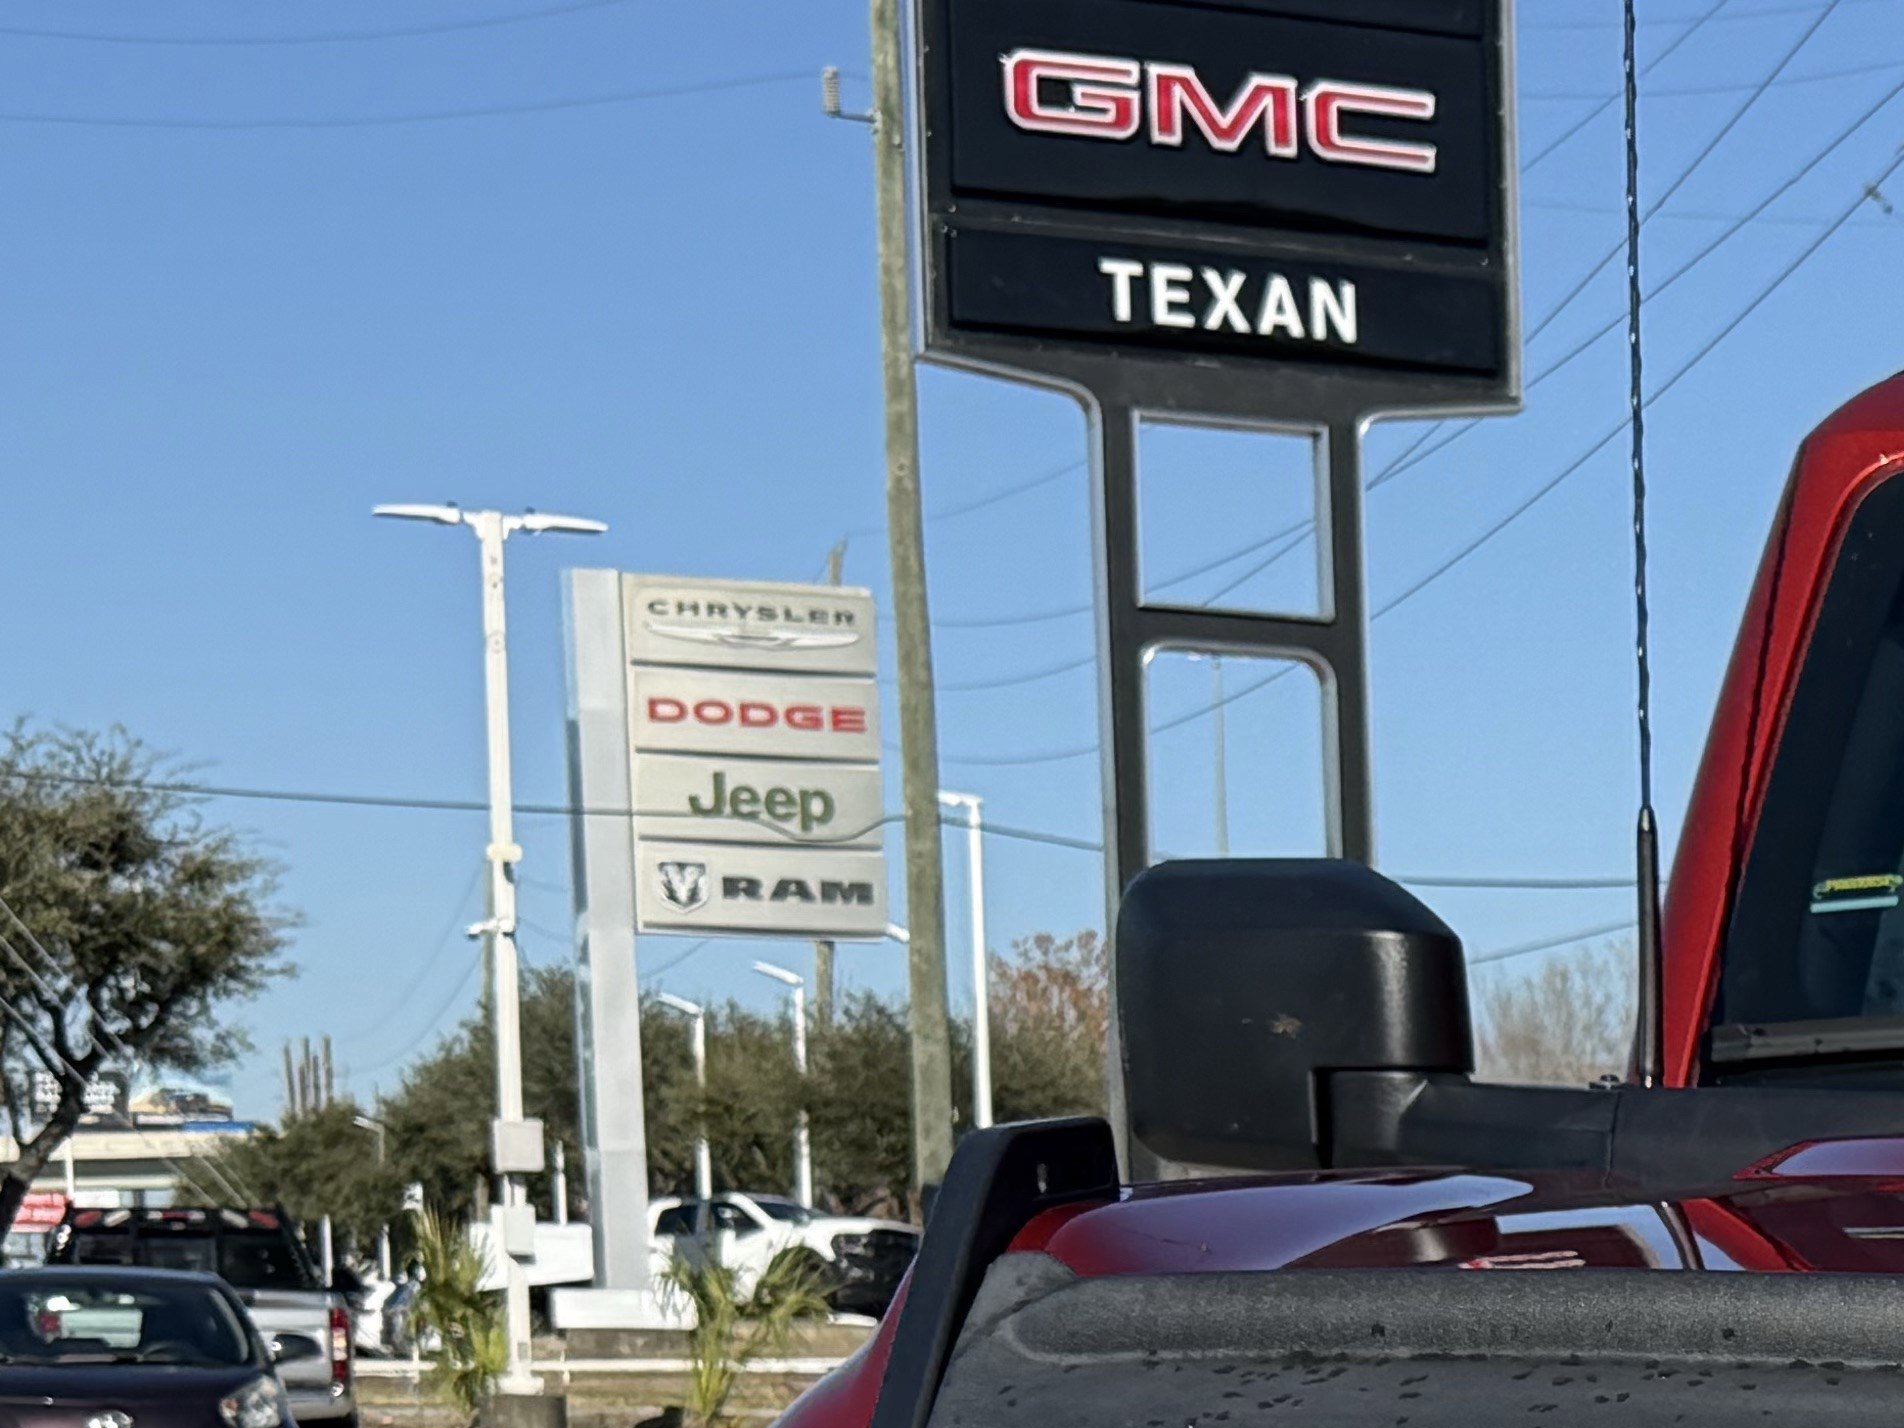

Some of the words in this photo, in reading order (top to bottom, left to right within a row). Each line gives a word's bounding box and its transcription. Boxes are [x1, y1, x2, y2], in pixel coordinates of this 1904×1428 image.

[1001, 49, 1436, 172] GMC
[1099, 258, 1357, 344] TEXAN
[648, 599, 856, 625] CHRYSLER
[648, 698, 866, 734] DODGE
[688, 772, 835, 832] Jeep
[722, 875, 874, 906] RAM
